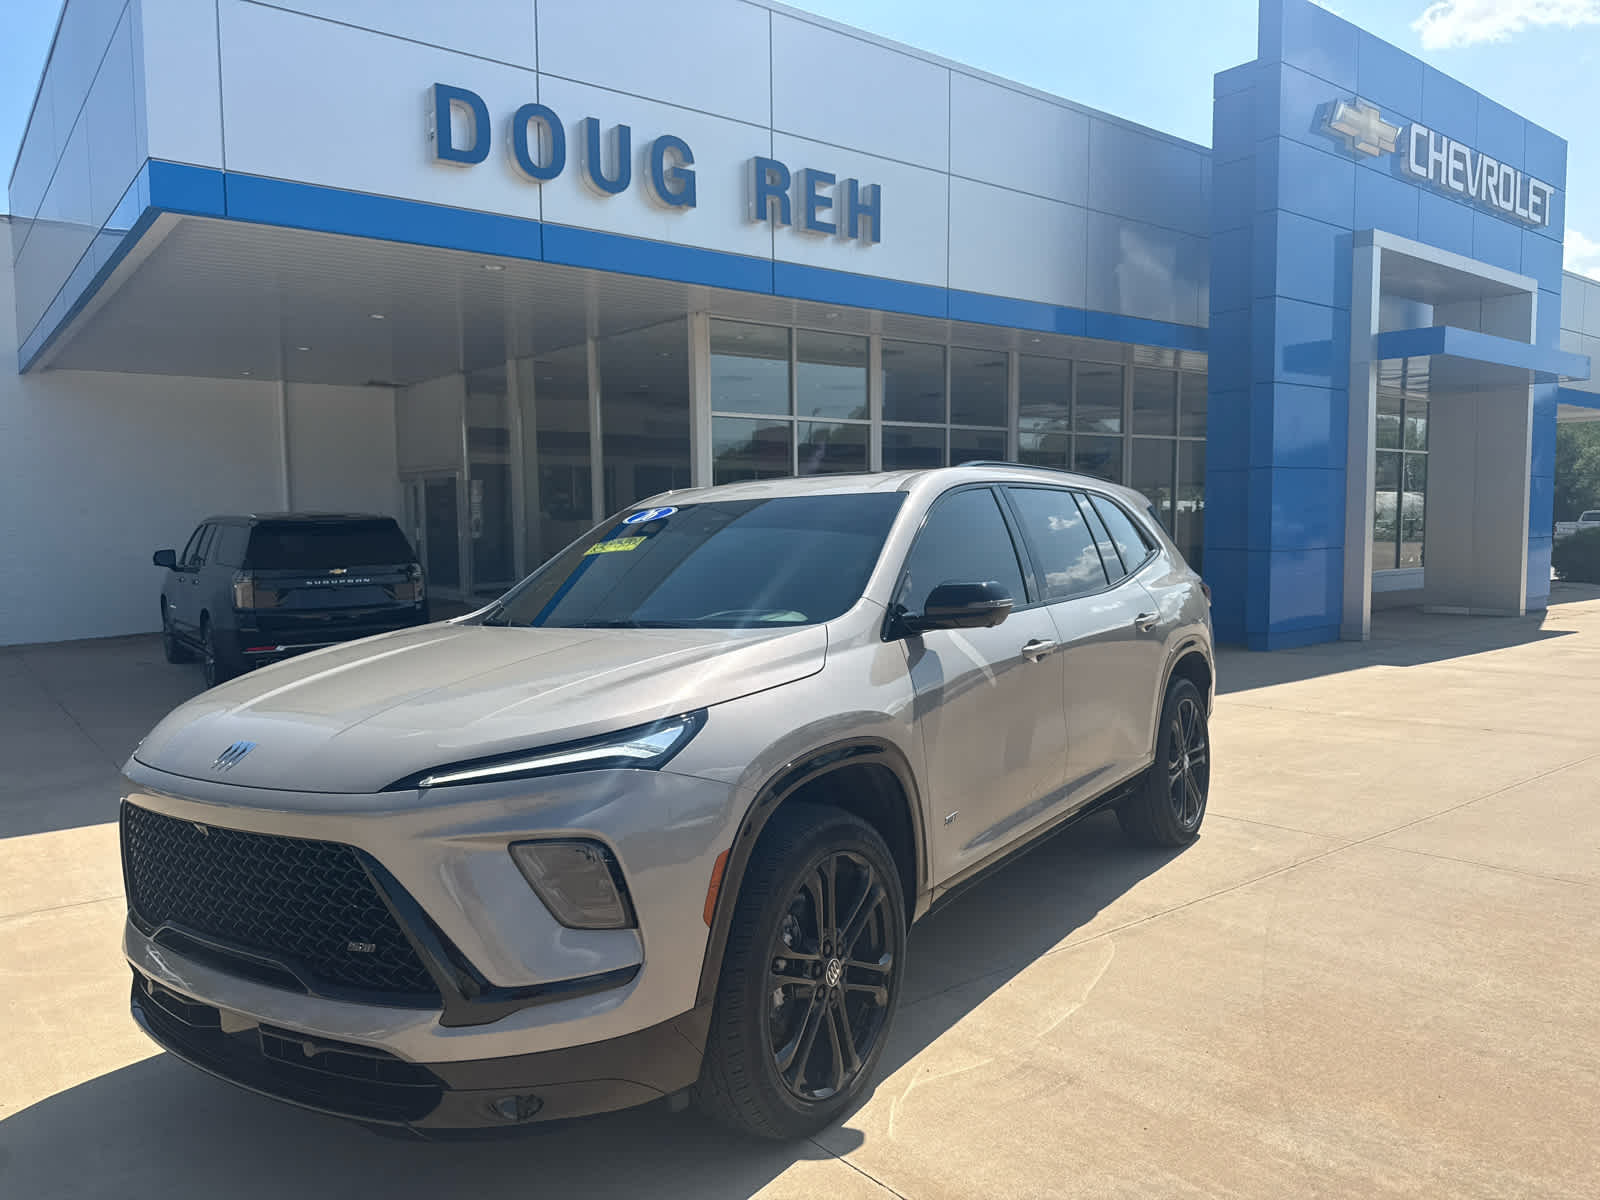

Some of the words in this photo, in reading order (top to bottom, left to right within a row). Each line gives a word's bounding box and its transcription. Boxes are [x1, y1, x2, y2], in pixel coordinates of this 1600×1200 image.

[431, 82, 697, 209] DOUG
[748, 155, 881, 245] REH
[1408, 122, 1555, 226] CHEVROLET
